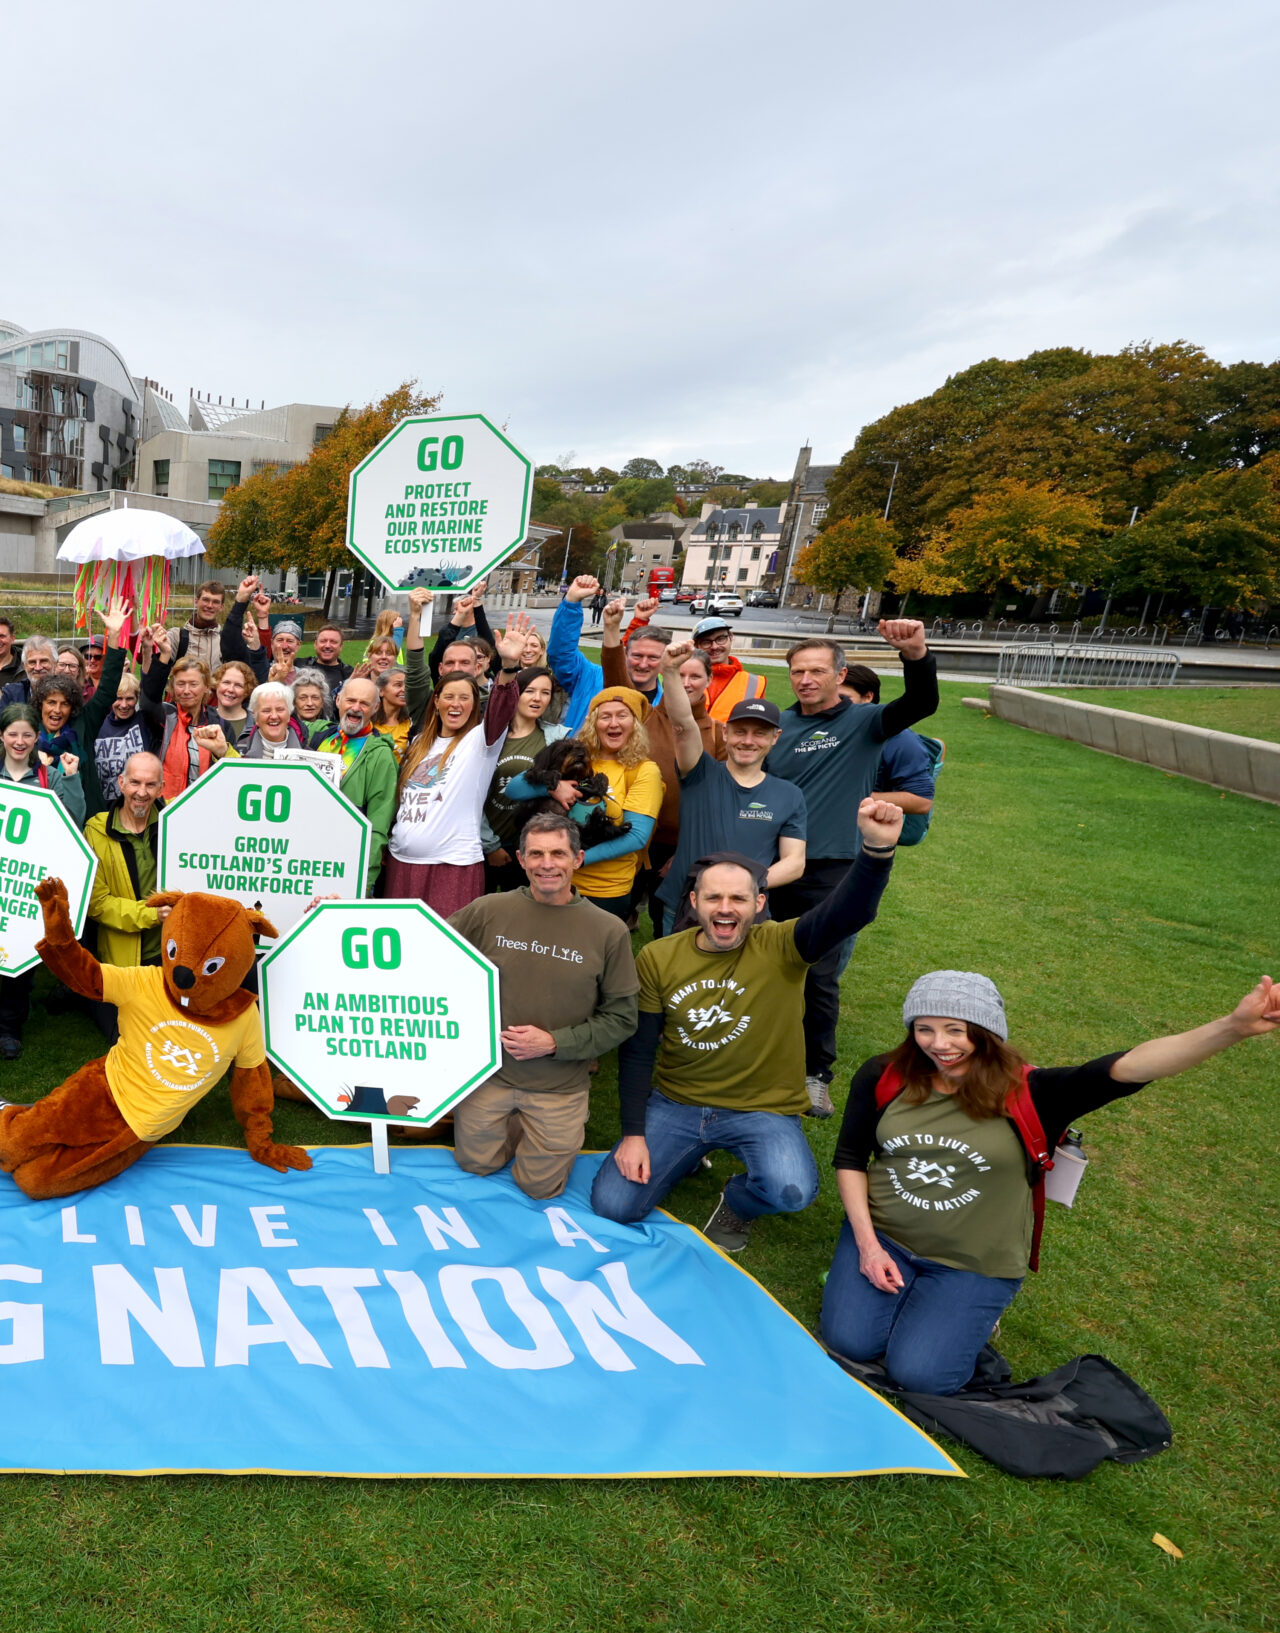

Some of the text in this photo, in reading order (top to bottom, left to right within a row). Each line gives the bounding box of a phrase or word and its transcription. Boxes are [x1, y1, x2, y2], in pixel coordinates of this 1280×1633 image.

[417, 435, 464, 472] GO
[404, 481, 472, 500] PROTECT
[385, 499, 489, 519] AND RESTORE
[387, 518, 483, 537] OUR MARINE
[385, 536, 482, 555] ECOSYSTEMS
[237, 783, 292, 824] GO
[234, 836, 289, 855] GROW
[179, 853, 345, 878] SCOTLAND'S GREEN
[207, 874, 313, 895] WORKFORCE
[341, 926, 402, 971] GO
[495, 935, 528, 951] Trees
[531, 940, 550, 955] for
[303, 991, 448, 1016] AN AMBITIOUS
[671, 982, 698, 1004] WANT
[701, 980, 715, 989] TO
[295, 1013, 460, 1040] PLAN TO REWILD
[720, 1015, 751, 1045] NATION
[326, 1037, 427, 1061] SCOTLAND
[914, 1134, 934, 1145] TO
[938, 1136, 970, 1154] LIVE
[967, 1152, 987, 1165] IN
[976, 1165, 992, 1173] A
[933, 1188, 981, 1212] NATION
[62, 1205, 297, 1247] LIVE
[364, 1206, 479, 1250] IN
[545, 1207, 609, 1253] A
[93, 1261, 705, 1372] NATION
